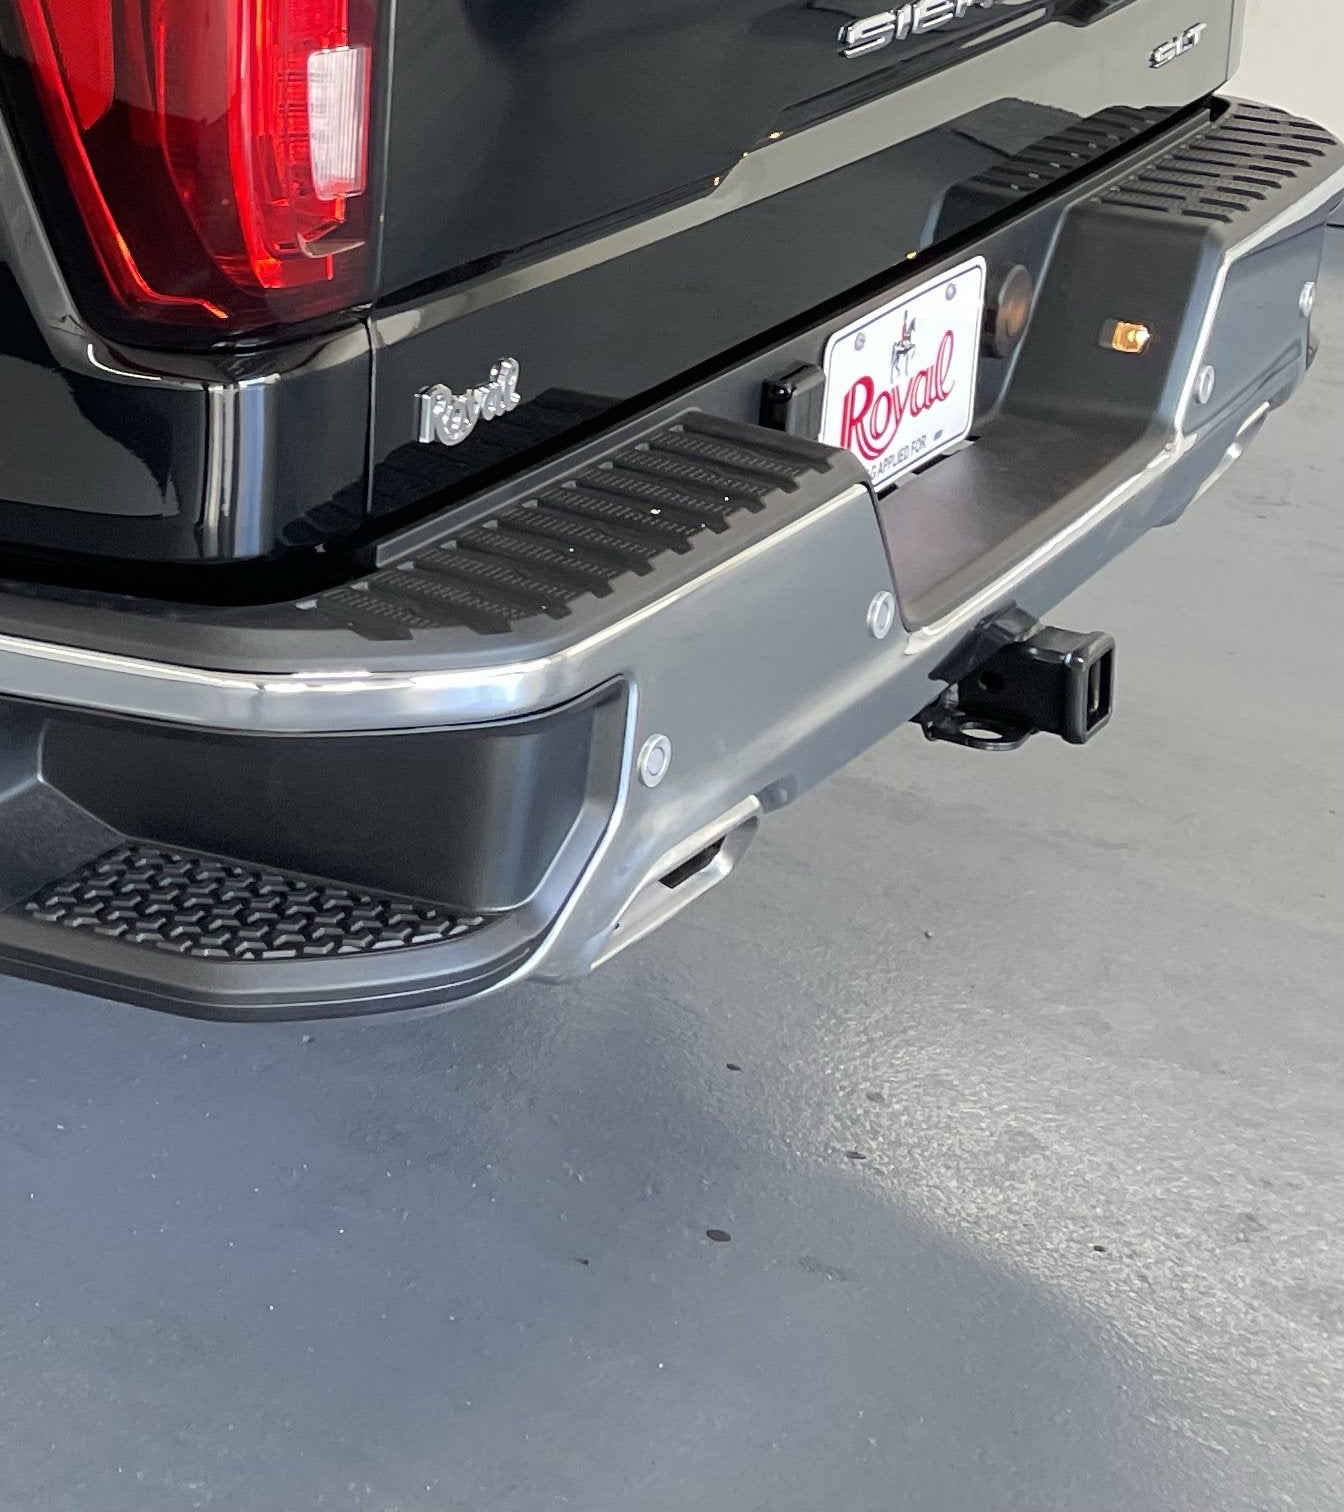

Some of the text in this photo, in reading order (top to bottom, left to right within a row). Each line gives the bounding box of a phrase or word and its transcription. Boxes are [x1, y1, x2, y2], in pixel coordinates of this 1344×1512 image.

[1148, 22, 1207, 69] SLT
[414, 357, 521, 447] Royal
[839, 329, 955, 461] Royal
